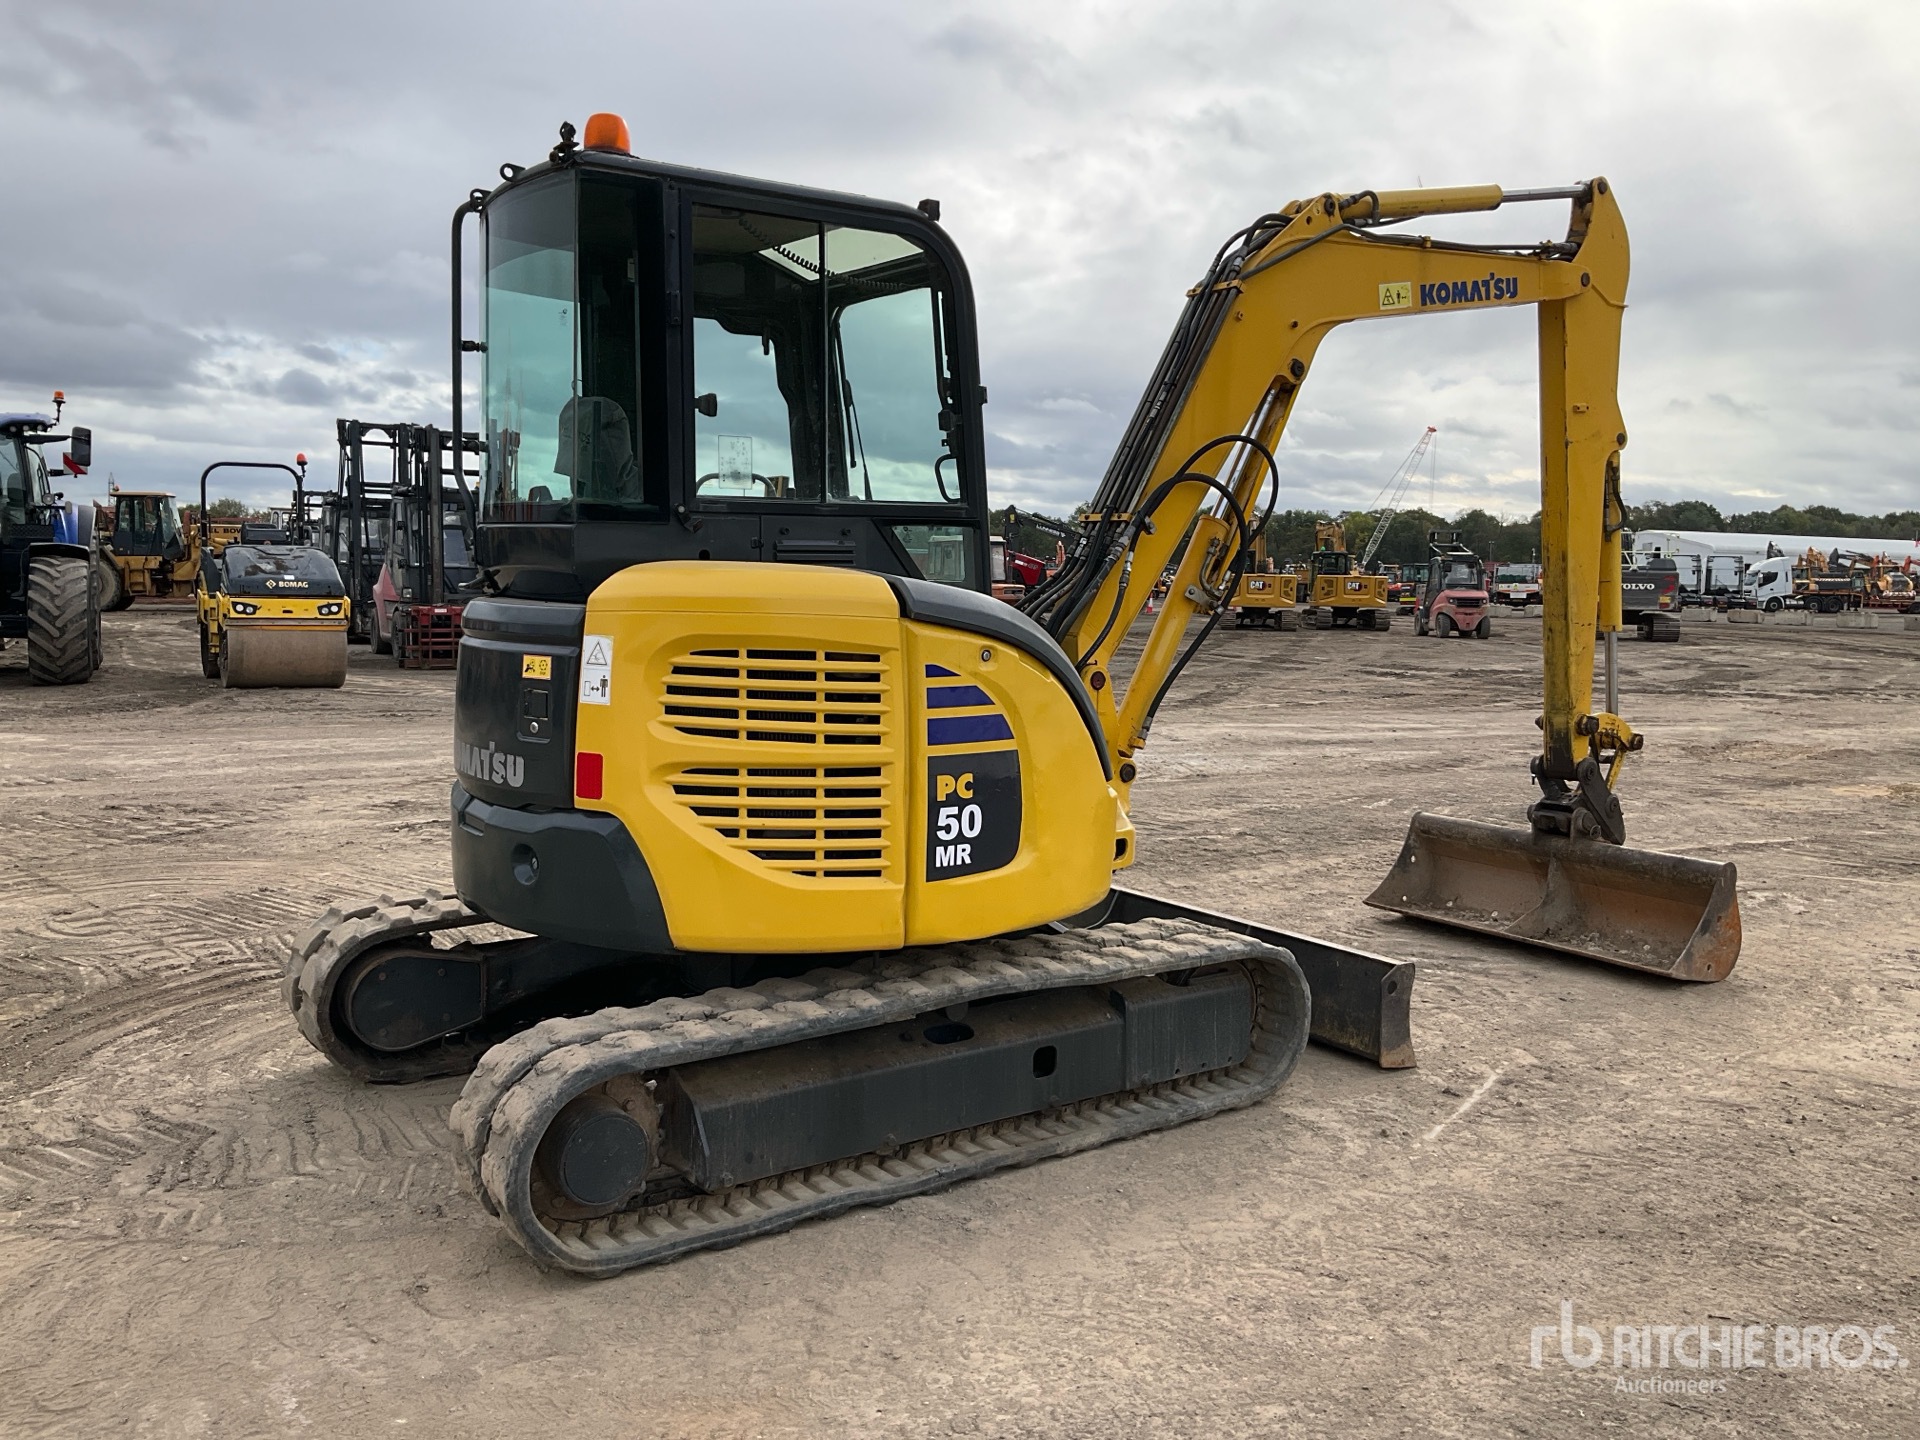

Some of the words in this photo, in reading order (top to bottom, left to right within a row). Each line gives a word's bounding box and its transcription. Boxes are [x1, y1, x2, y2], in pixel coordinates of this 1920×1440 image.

[1420, 272, 1518, 306] KOMATSU
[1250, 581, 1264, 589] CAT
[460, 741, 525, 788] MATSU
[936, 772, 974, 802] PC
[936, 804, 982, 841] 50
[935, 843, 972, 868] MR
